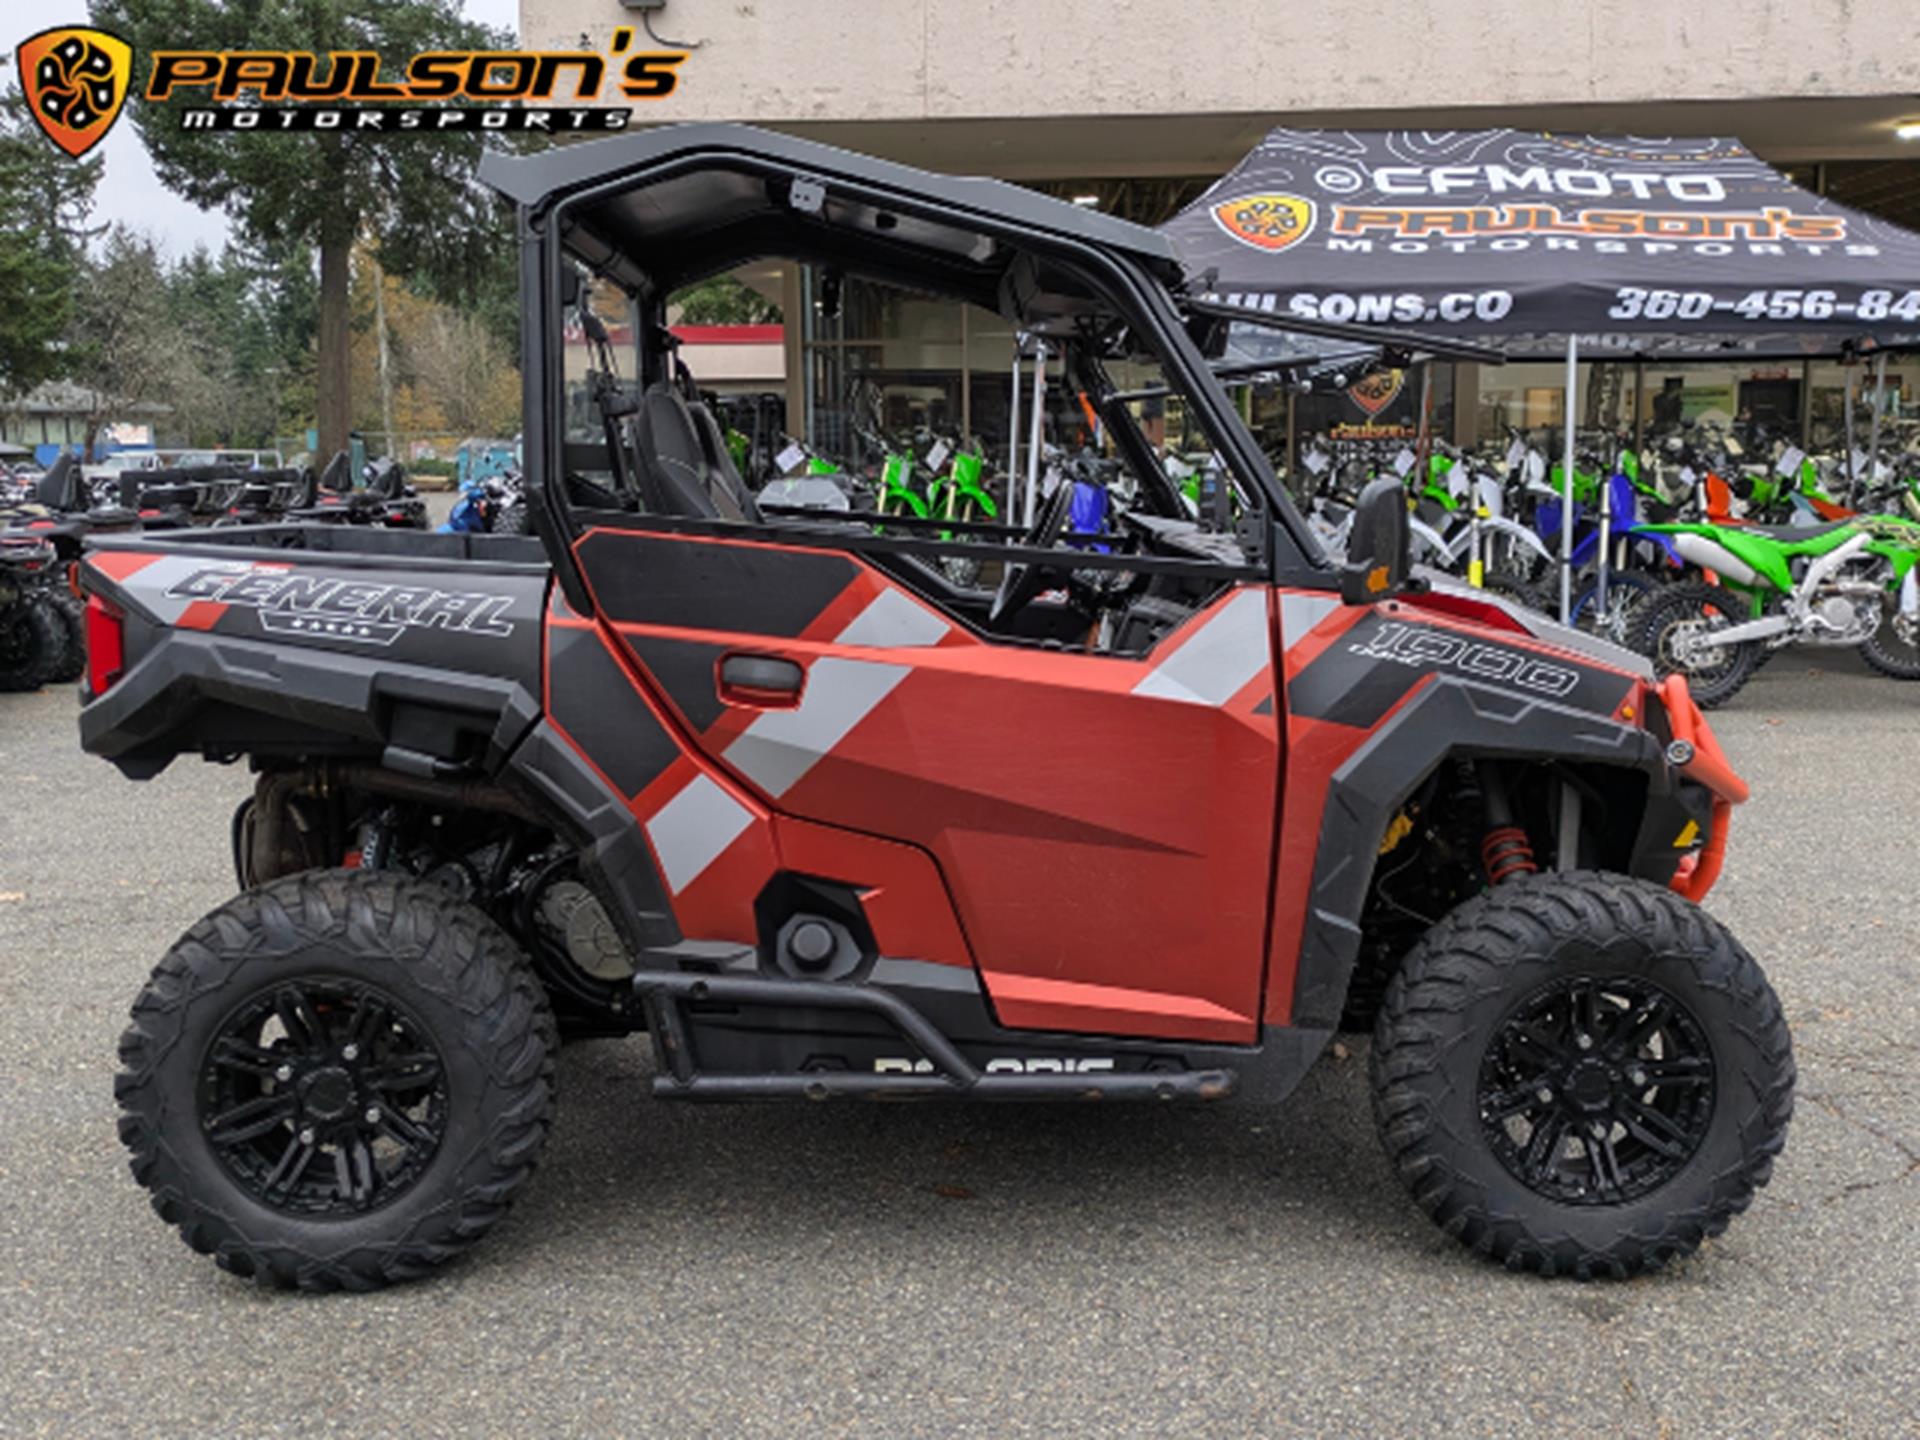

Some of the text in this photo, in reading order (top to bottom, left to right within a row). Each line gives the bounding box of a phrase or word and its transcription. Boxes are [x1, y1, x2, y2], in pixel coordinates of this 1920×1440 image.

[1373, 165, 1727, 202] CFMOTO
[1327, 237, 1881, 256] MOTORSPORTS
[164, 569, 517, 637] GENERAL
[1370, 622, 1580, 697] 1000
